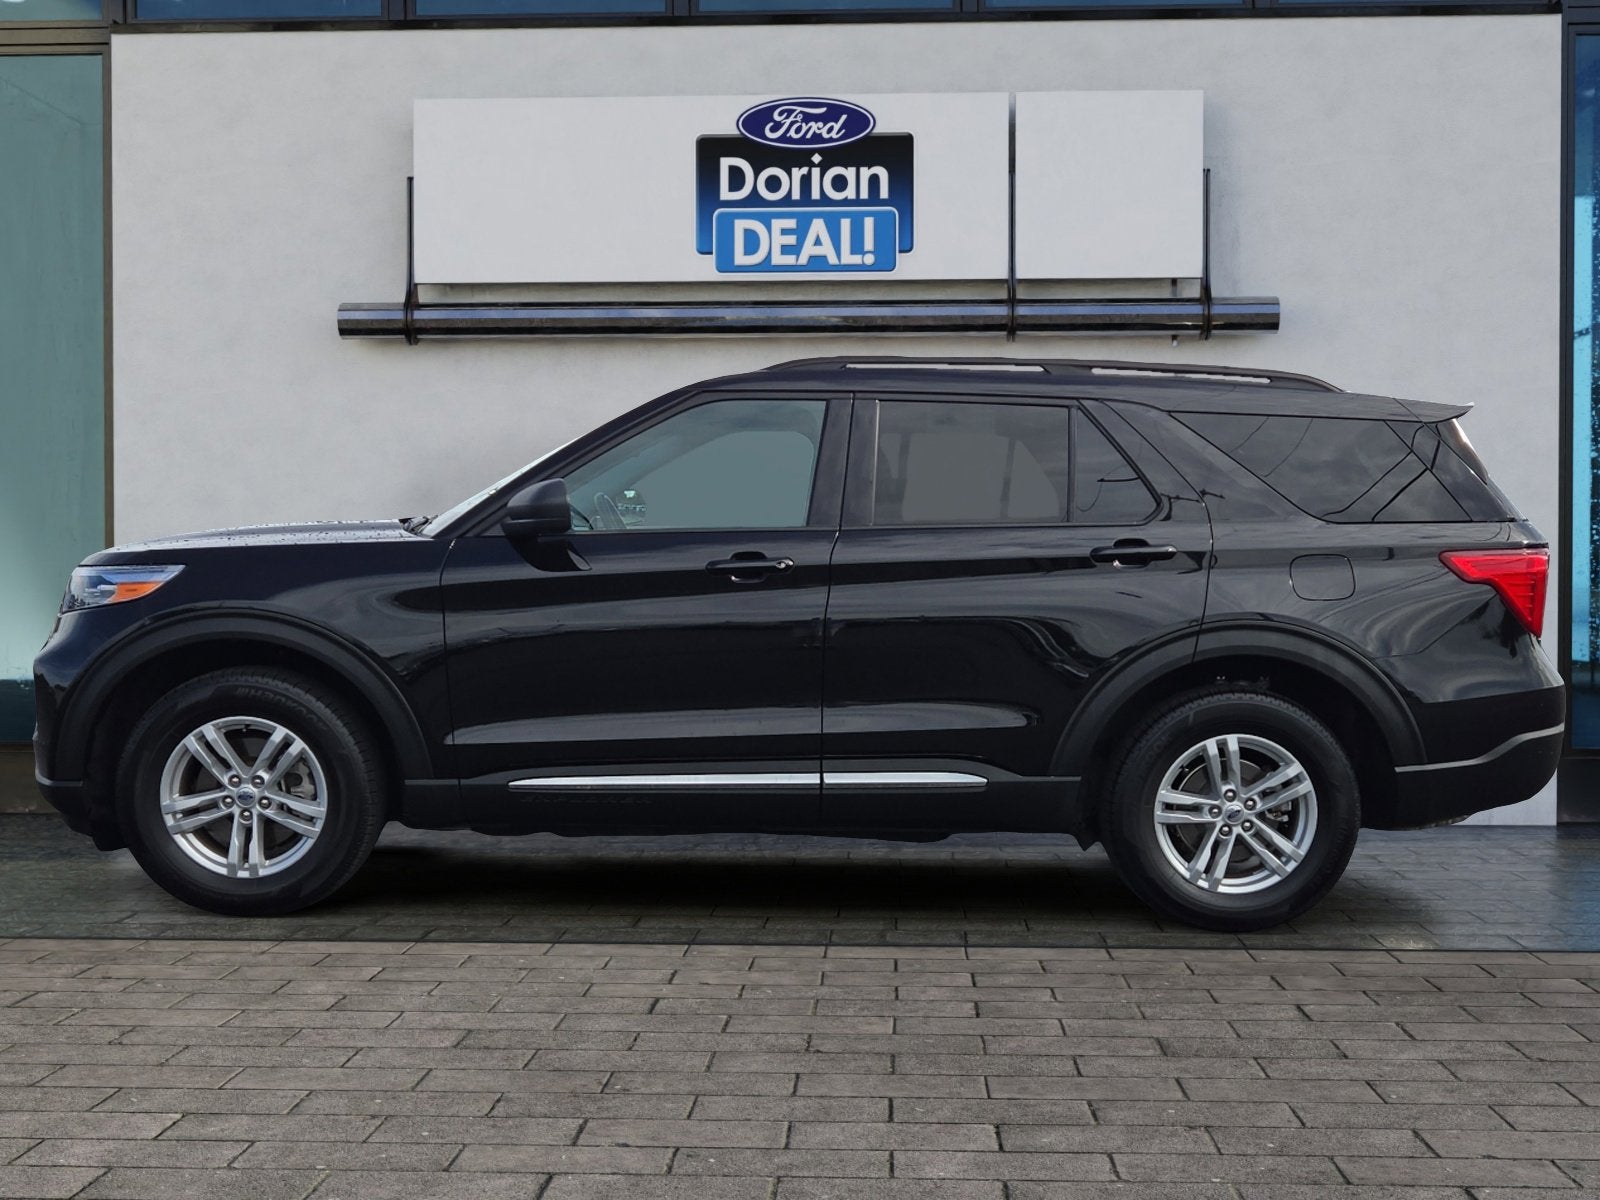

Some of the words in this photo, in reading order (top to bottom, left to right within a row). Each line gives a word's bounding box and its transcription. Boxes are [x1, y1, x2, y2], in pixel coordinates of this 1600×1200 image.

[764, 105, 848, 139] Ford
[719, 153, 889, 201] Dorian
[733, 217, 876, 266] DEAL!
